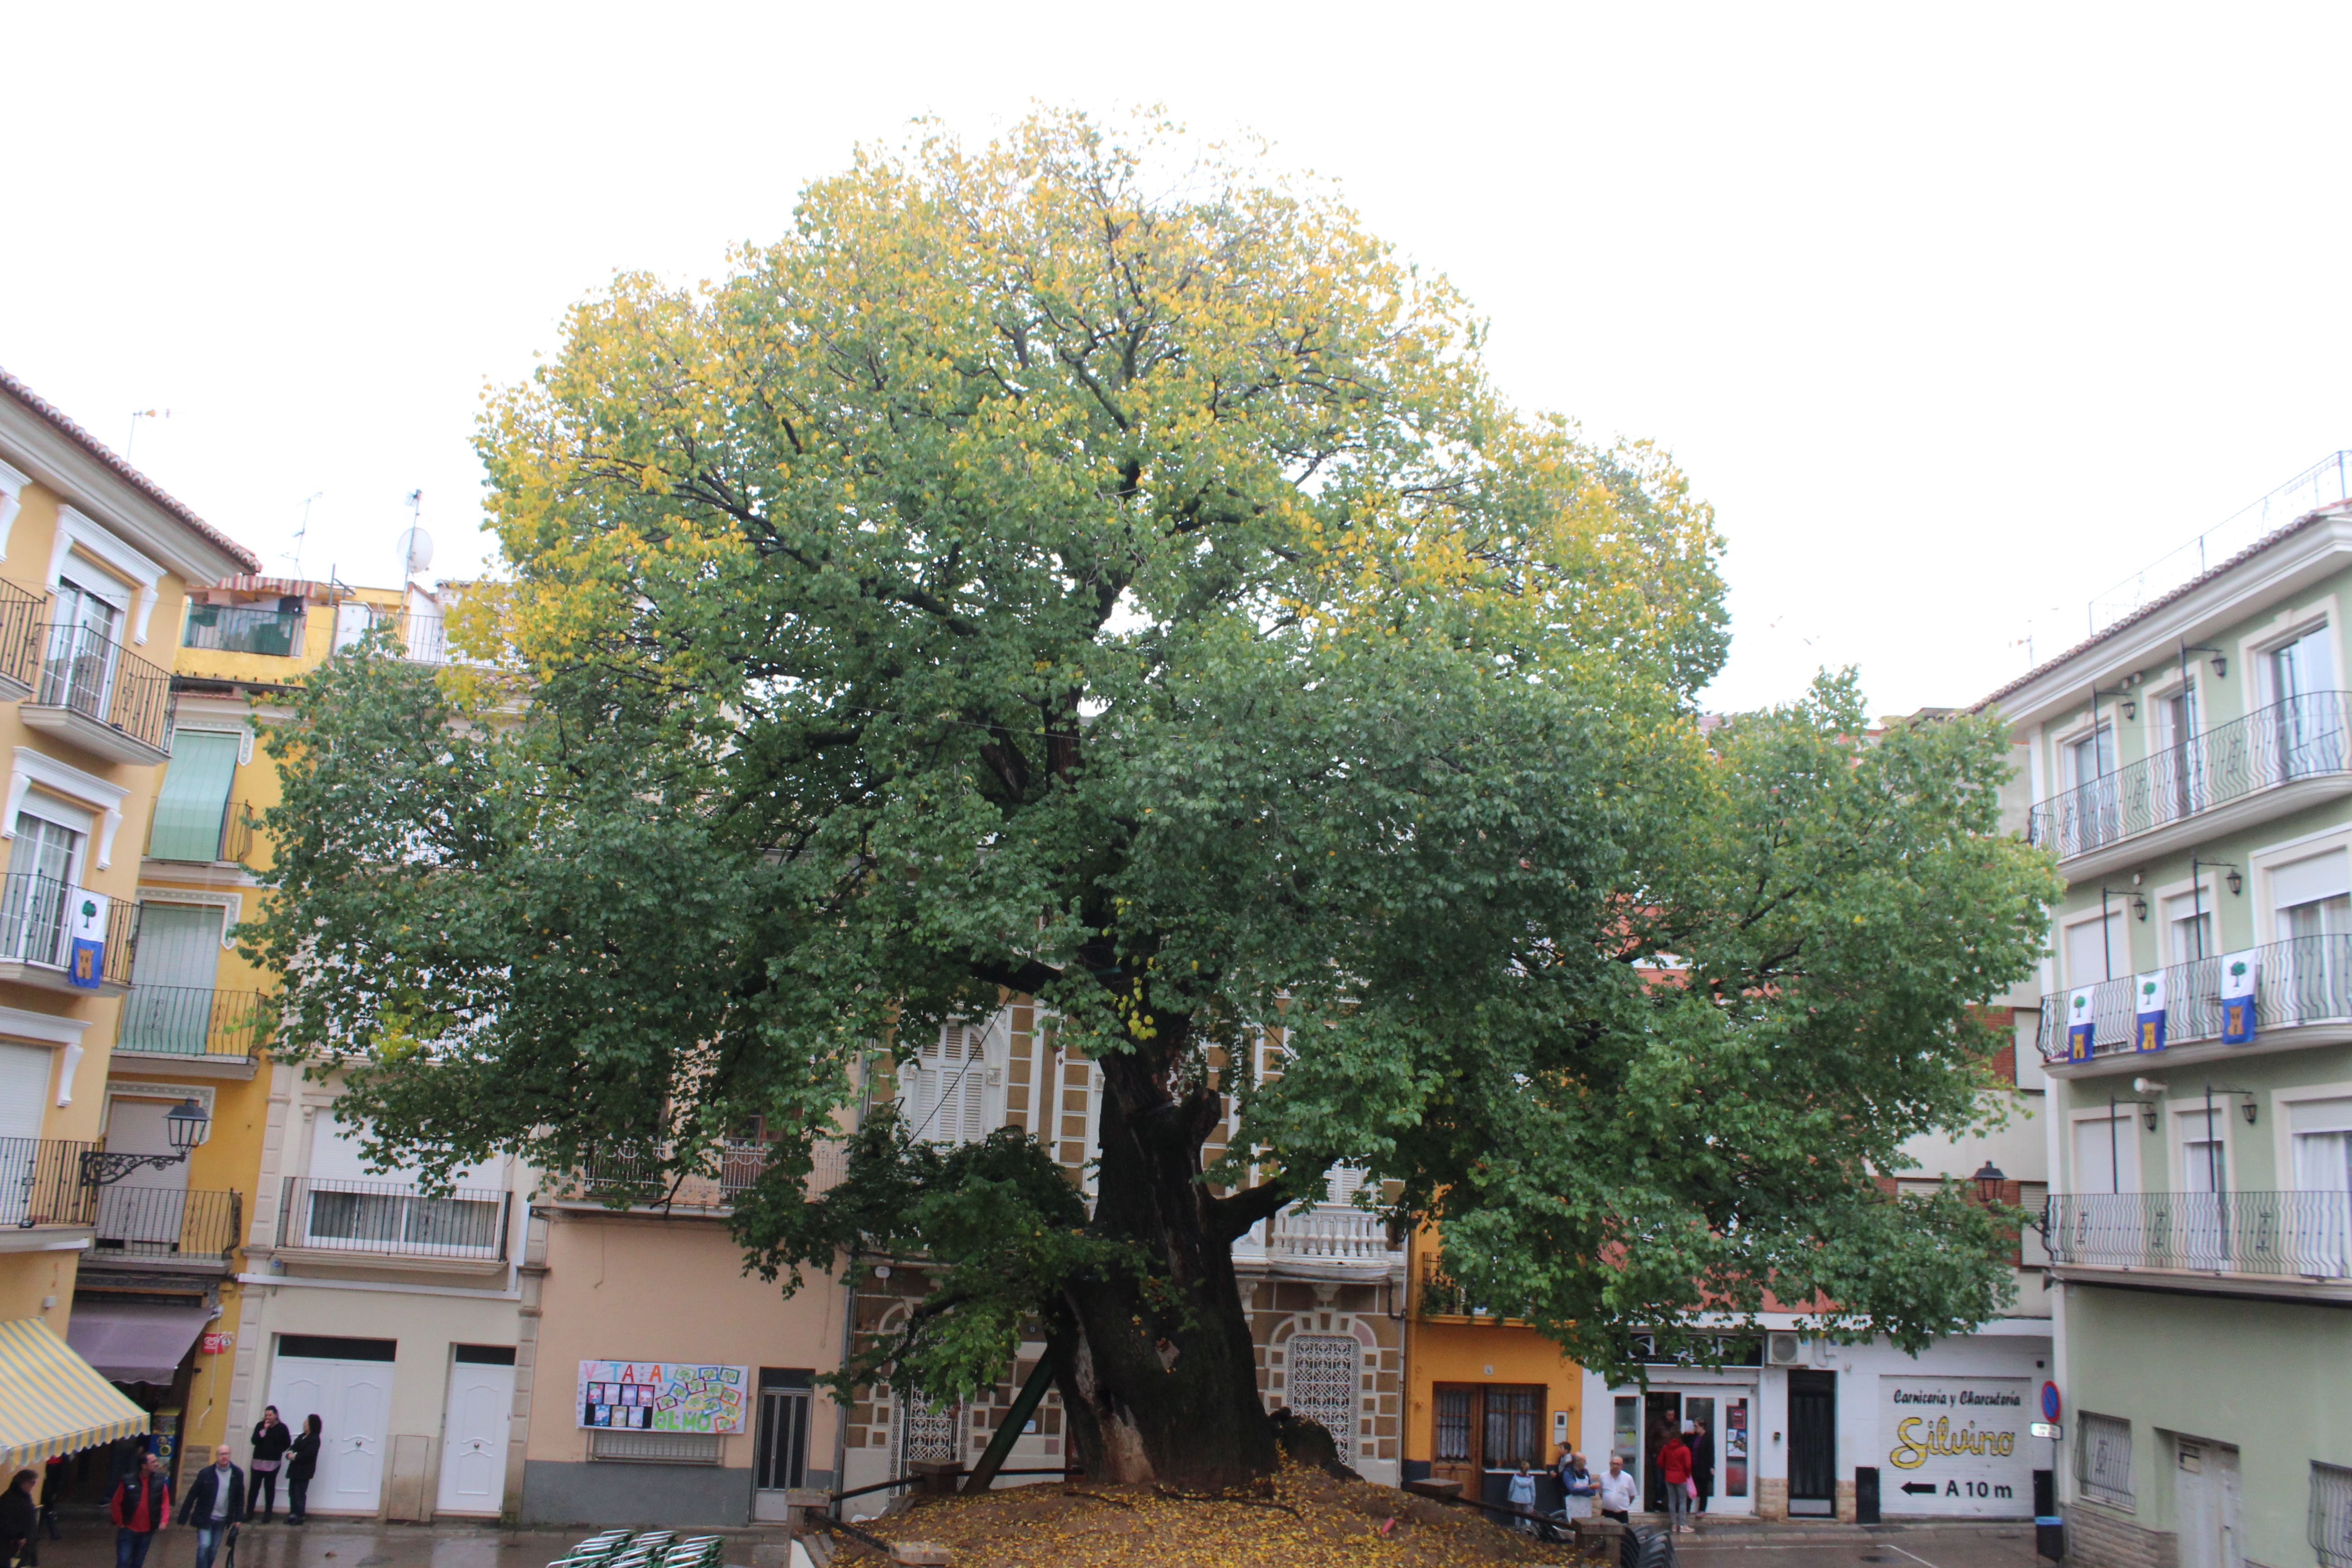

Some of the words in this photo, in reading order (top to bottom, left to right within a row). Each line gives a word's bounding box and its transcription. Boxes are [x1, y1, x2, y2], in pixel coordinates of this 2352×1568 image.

[648, 1364, 675, 1382] AL
[1950, 1394, 1957, 1407] y
[654, 1411, 711, 1431] OLMO
[1890, 1416, 2015, 1469] Silvino
[1945, 1480, 1959, 1496] A
[1966, 1481, 1988, 1497] 10
[1994, 1485, 2013, 1498] m
